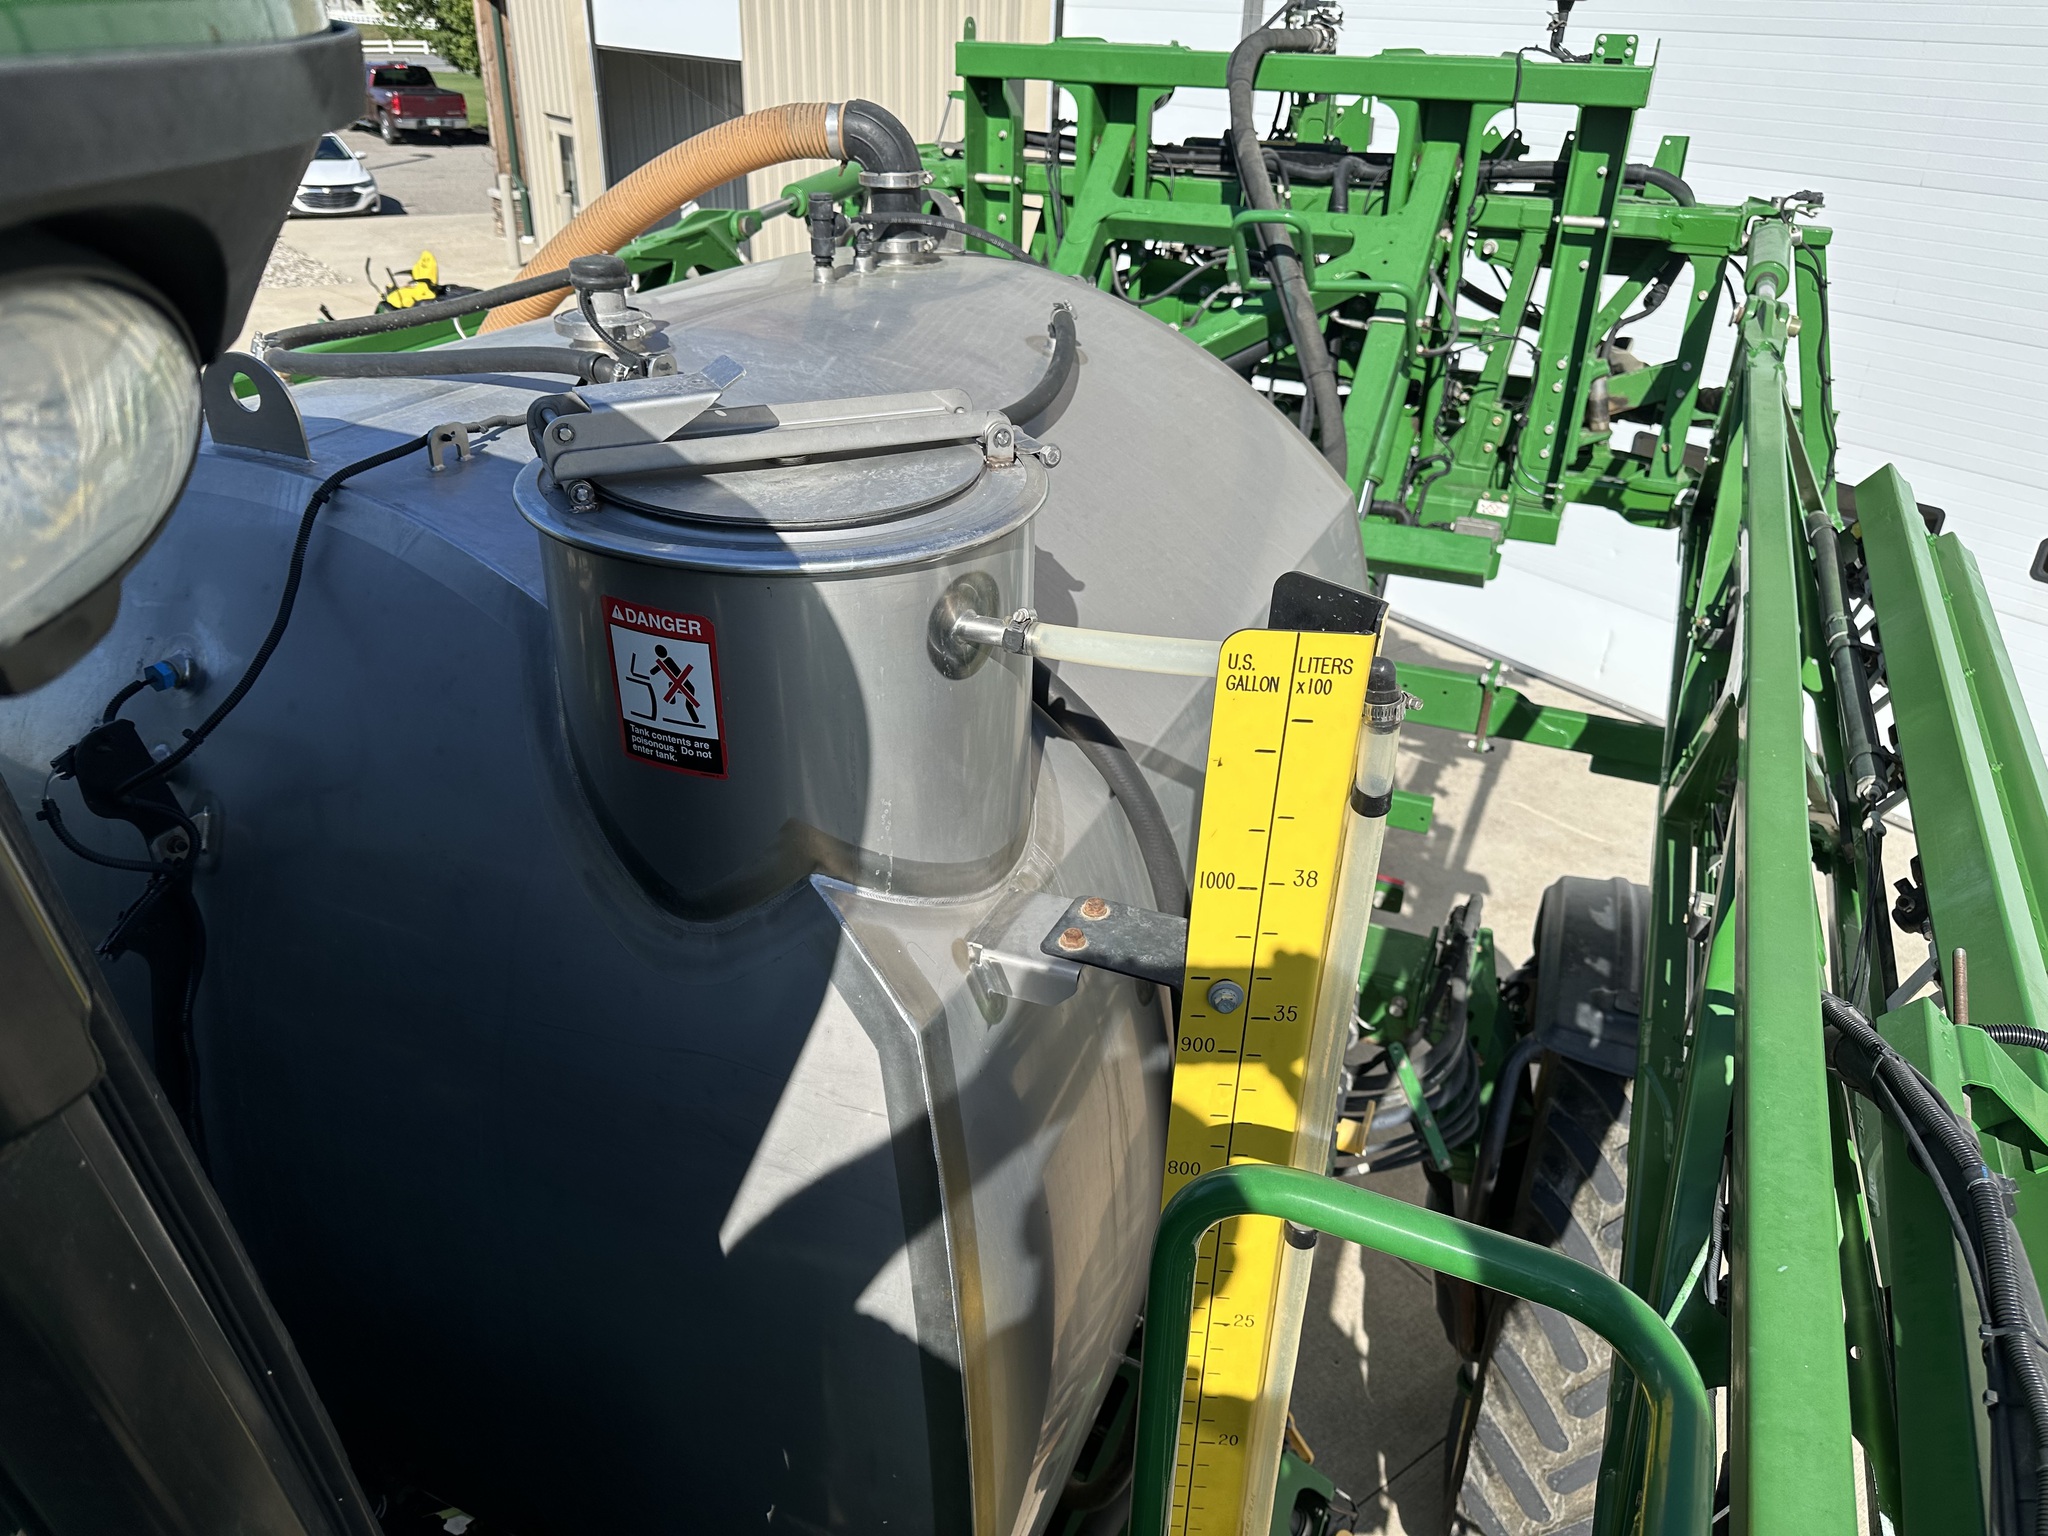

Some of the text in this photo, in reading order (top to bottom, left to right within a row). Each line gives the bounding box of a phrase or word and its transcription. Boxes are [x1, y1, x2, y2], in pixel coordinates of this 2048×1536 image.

[625, 608, 702, 635] DANGER
[1228, 653, 1256, 671] U.S.
[1298, 656, 1354, 675] LITERS
[1226, 674, 1280, 693] GALLON
[1295, 678, 1333, 695] x100
[630, 724, 710, 749] Tank contents are
[631, 734, 712, 759] poisonous. Do not
[632, 743, 678, 761] enter tank.
[1200, 871, 1236, 890] 1000
[1293, 869, 1319, 888] 38
[1273, 1005, 1298, 1022] 35
[1180, 1037, 1215, 1053] 900
[1167, 1160, 1201, 1177] 800
[1233, 1314, 1255, 1328] 25
[1218, 1434, 1239, 1447] 20
